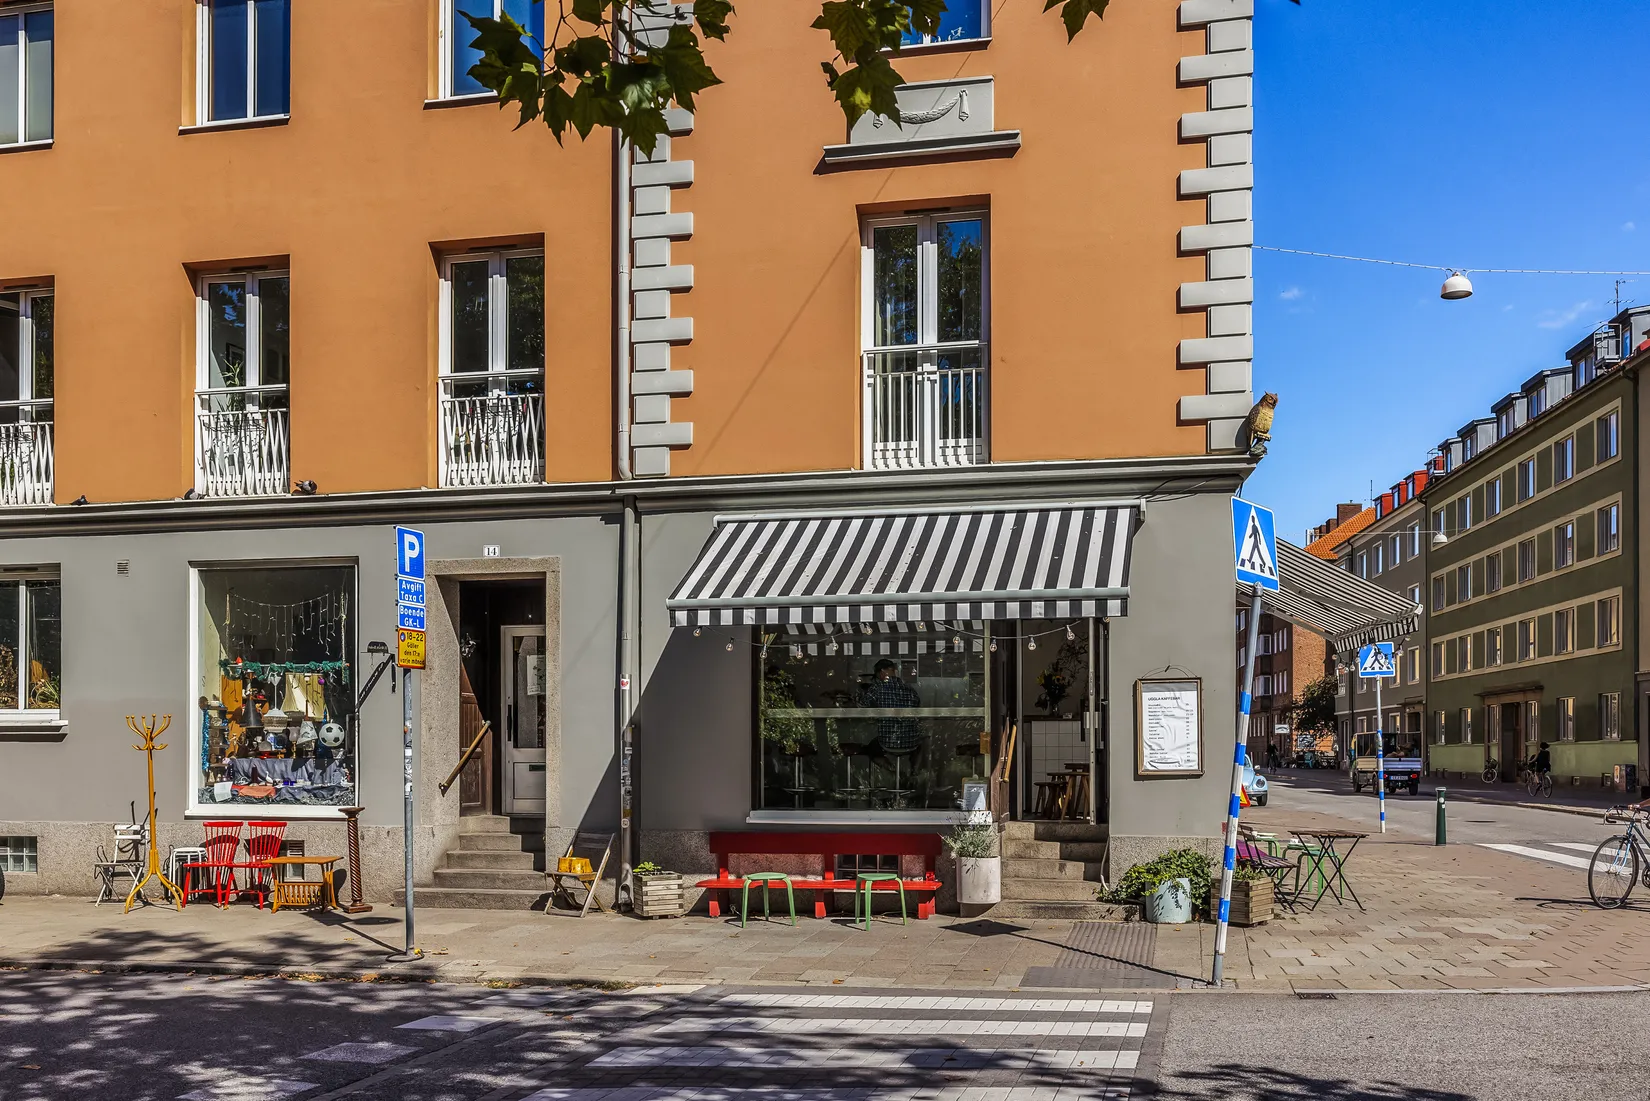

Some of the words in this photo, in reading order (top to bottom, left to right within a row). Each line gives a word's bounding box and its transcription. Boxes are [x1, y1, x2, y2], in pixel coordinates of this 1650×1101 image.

[404, 533, 420, 572] P
[487, 547, 498, 556] 14
[402, 580, 422, 592] Avgift
[401, 591, 416, 602] Taxa
[418, 594, 423, 603] C
[400, 606, 424, 618] Boende
[406, 631, 424, 642] 18-22
